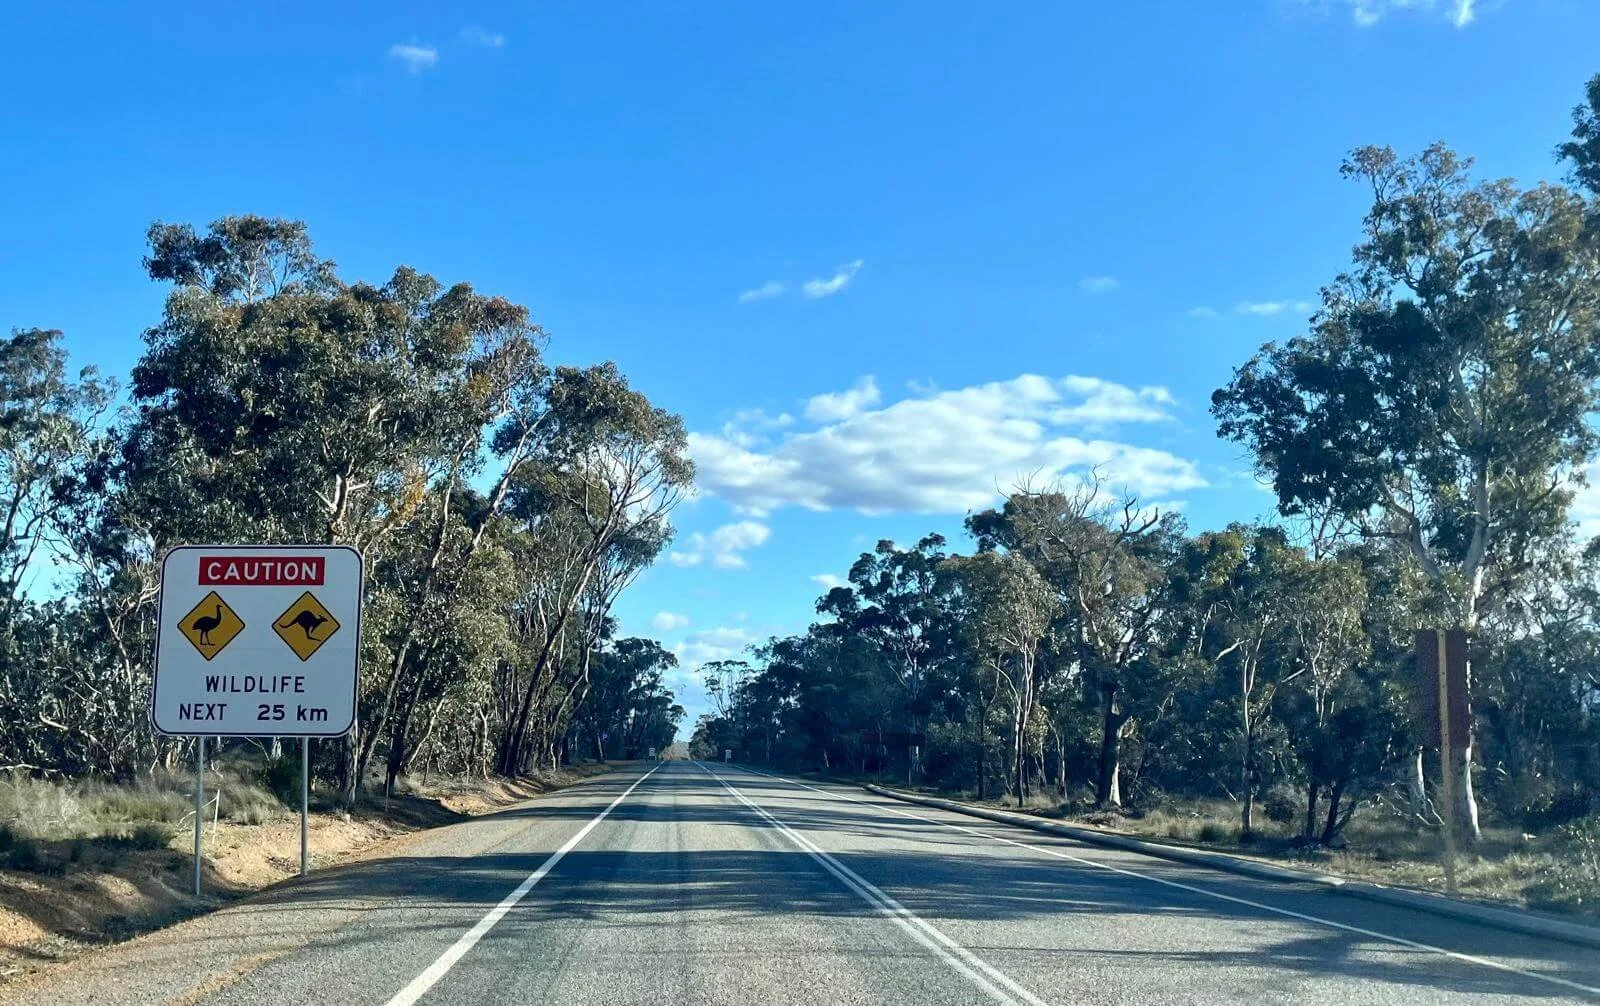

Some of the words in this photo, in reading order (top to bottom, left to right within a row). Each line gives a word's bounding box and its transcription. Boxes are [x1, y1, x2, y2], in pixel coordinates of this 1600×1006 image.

[207, 562, 317, 581] CAUTION
[205, 675, 305, 693] WILDLIFE
[179, 703, 227, 721] NEXT
[257, 704, 285, 721] 25
[296, 704, 328, 721] km
